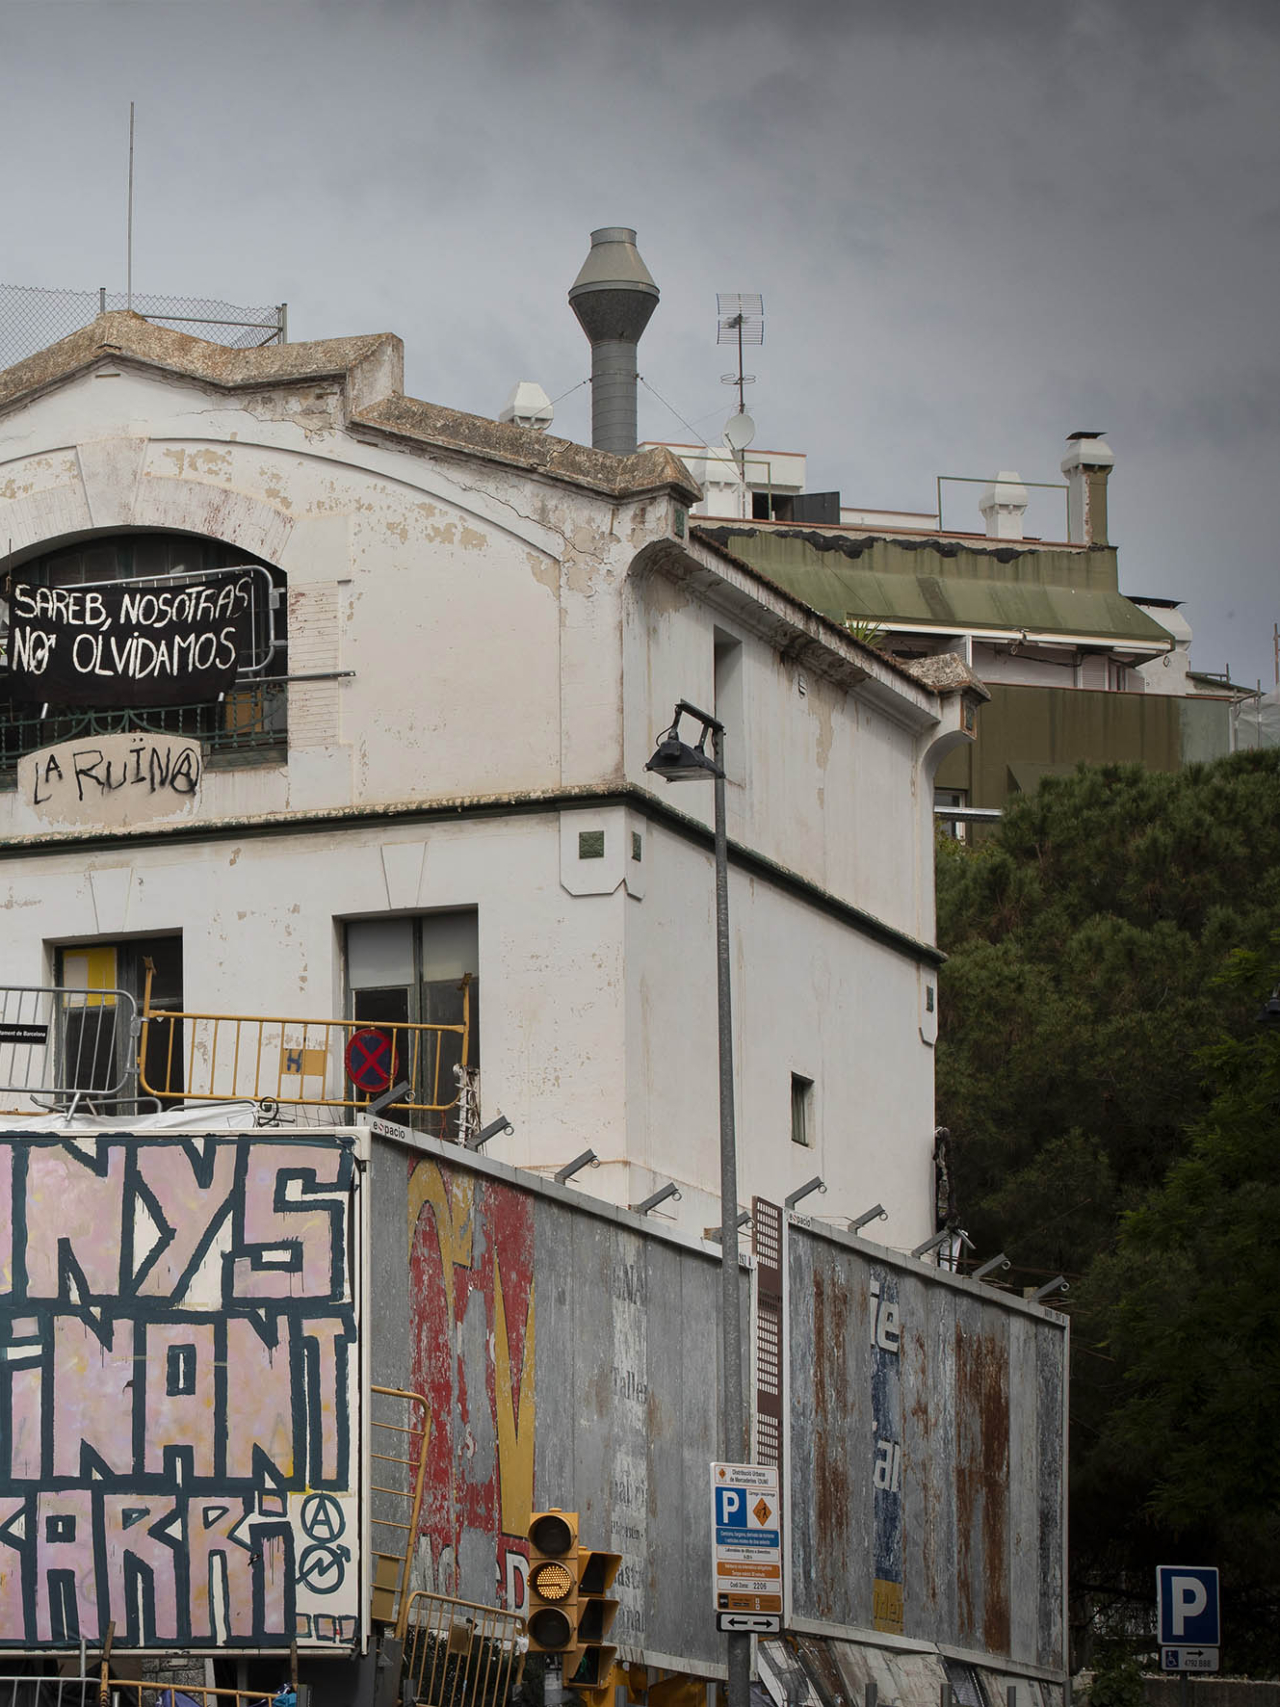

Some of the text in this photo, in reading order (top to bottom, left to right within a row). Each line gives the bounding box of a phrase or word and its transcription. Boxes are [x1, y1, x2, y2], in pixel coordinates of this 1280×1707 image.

[14, 577, 252, 631] SAREB, NOSOTRAS
[33, 754, 64, 805] LA
[722, 1490, 740, 1523] P
[1171, 1576, 1207, 1636] P
